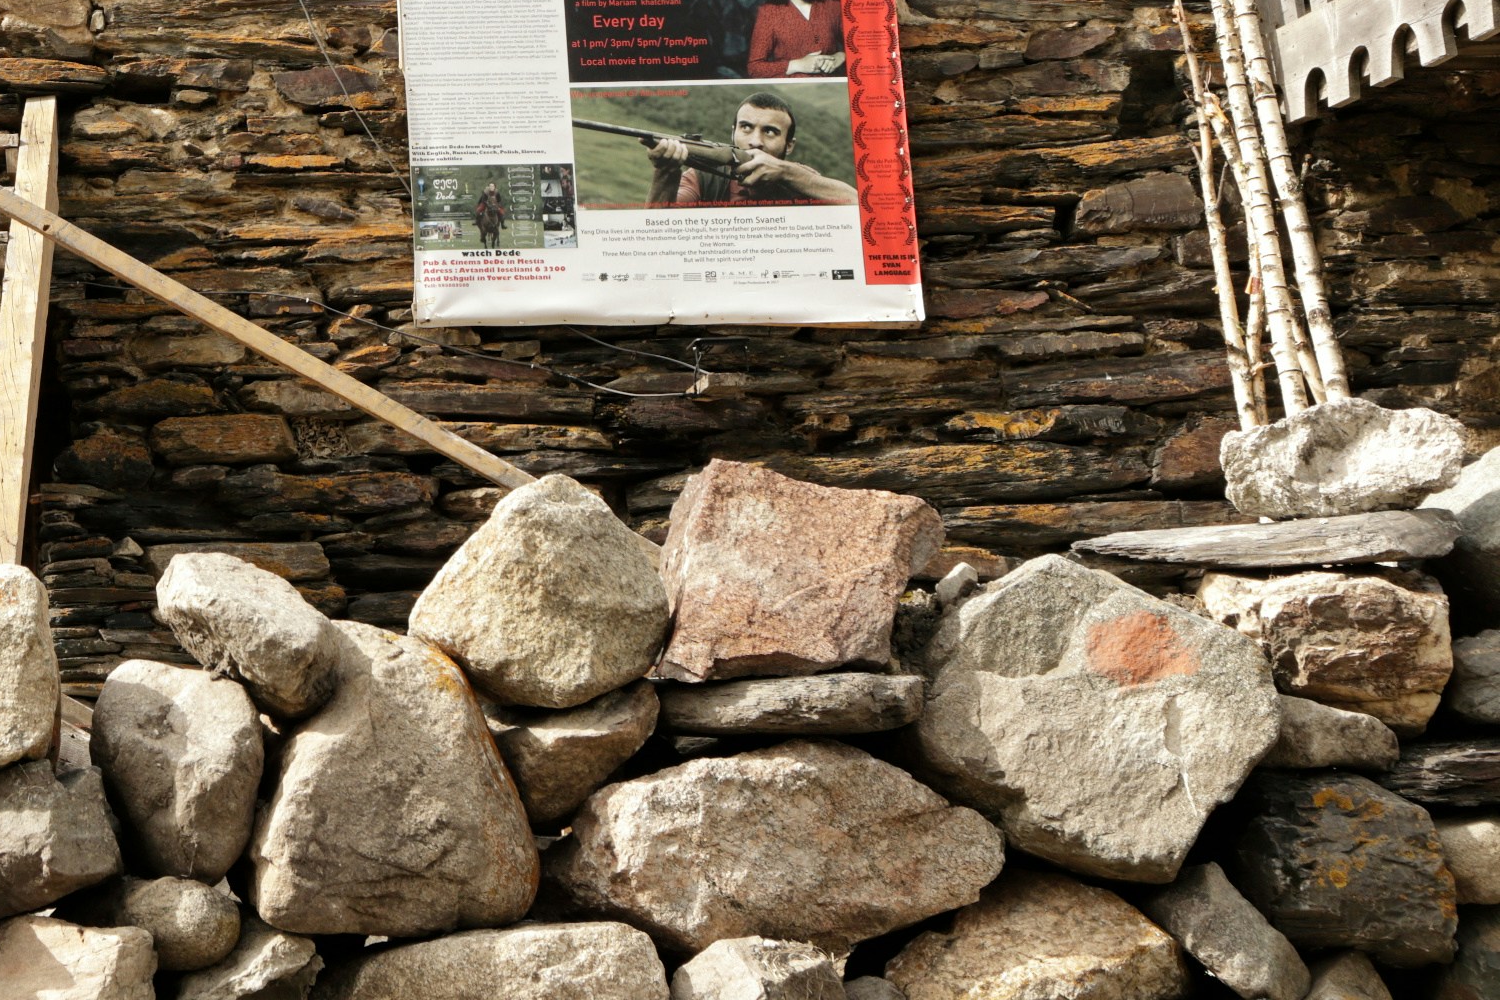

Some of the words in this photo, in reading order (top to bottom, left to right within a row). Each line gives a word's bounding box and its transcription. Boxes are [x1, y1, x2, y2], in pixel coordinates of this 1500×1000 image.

[581, 0, 597, 7] film
[598, 0, 607, 8] by
[593, 14, 635, 31] Every
[639, 14, 665, 30] day
[571, 40, 581, 48] at
[589, 38, 609, 49] pm/
[610, 37, 635, 49] 3pm/
[636, 36, 662, 49] 5pm/
[580, 57, 606, 66] Local
[608, 56, 637, 65] movie
[638, 56, 661, 65] from
[663, 55, 699, 67] Ushguli
[645, 218, 670, 226] Based
[684, 218, 699, 226] the
[700, 218, 709, 227] ty
[711, 218, 732, 226] story
[733, 216, 754, 224] from
[755, 216, 786, 224] Svaneti
[774, 232, 800, 240] wedding
[495, 249, 521, 257] Dede
